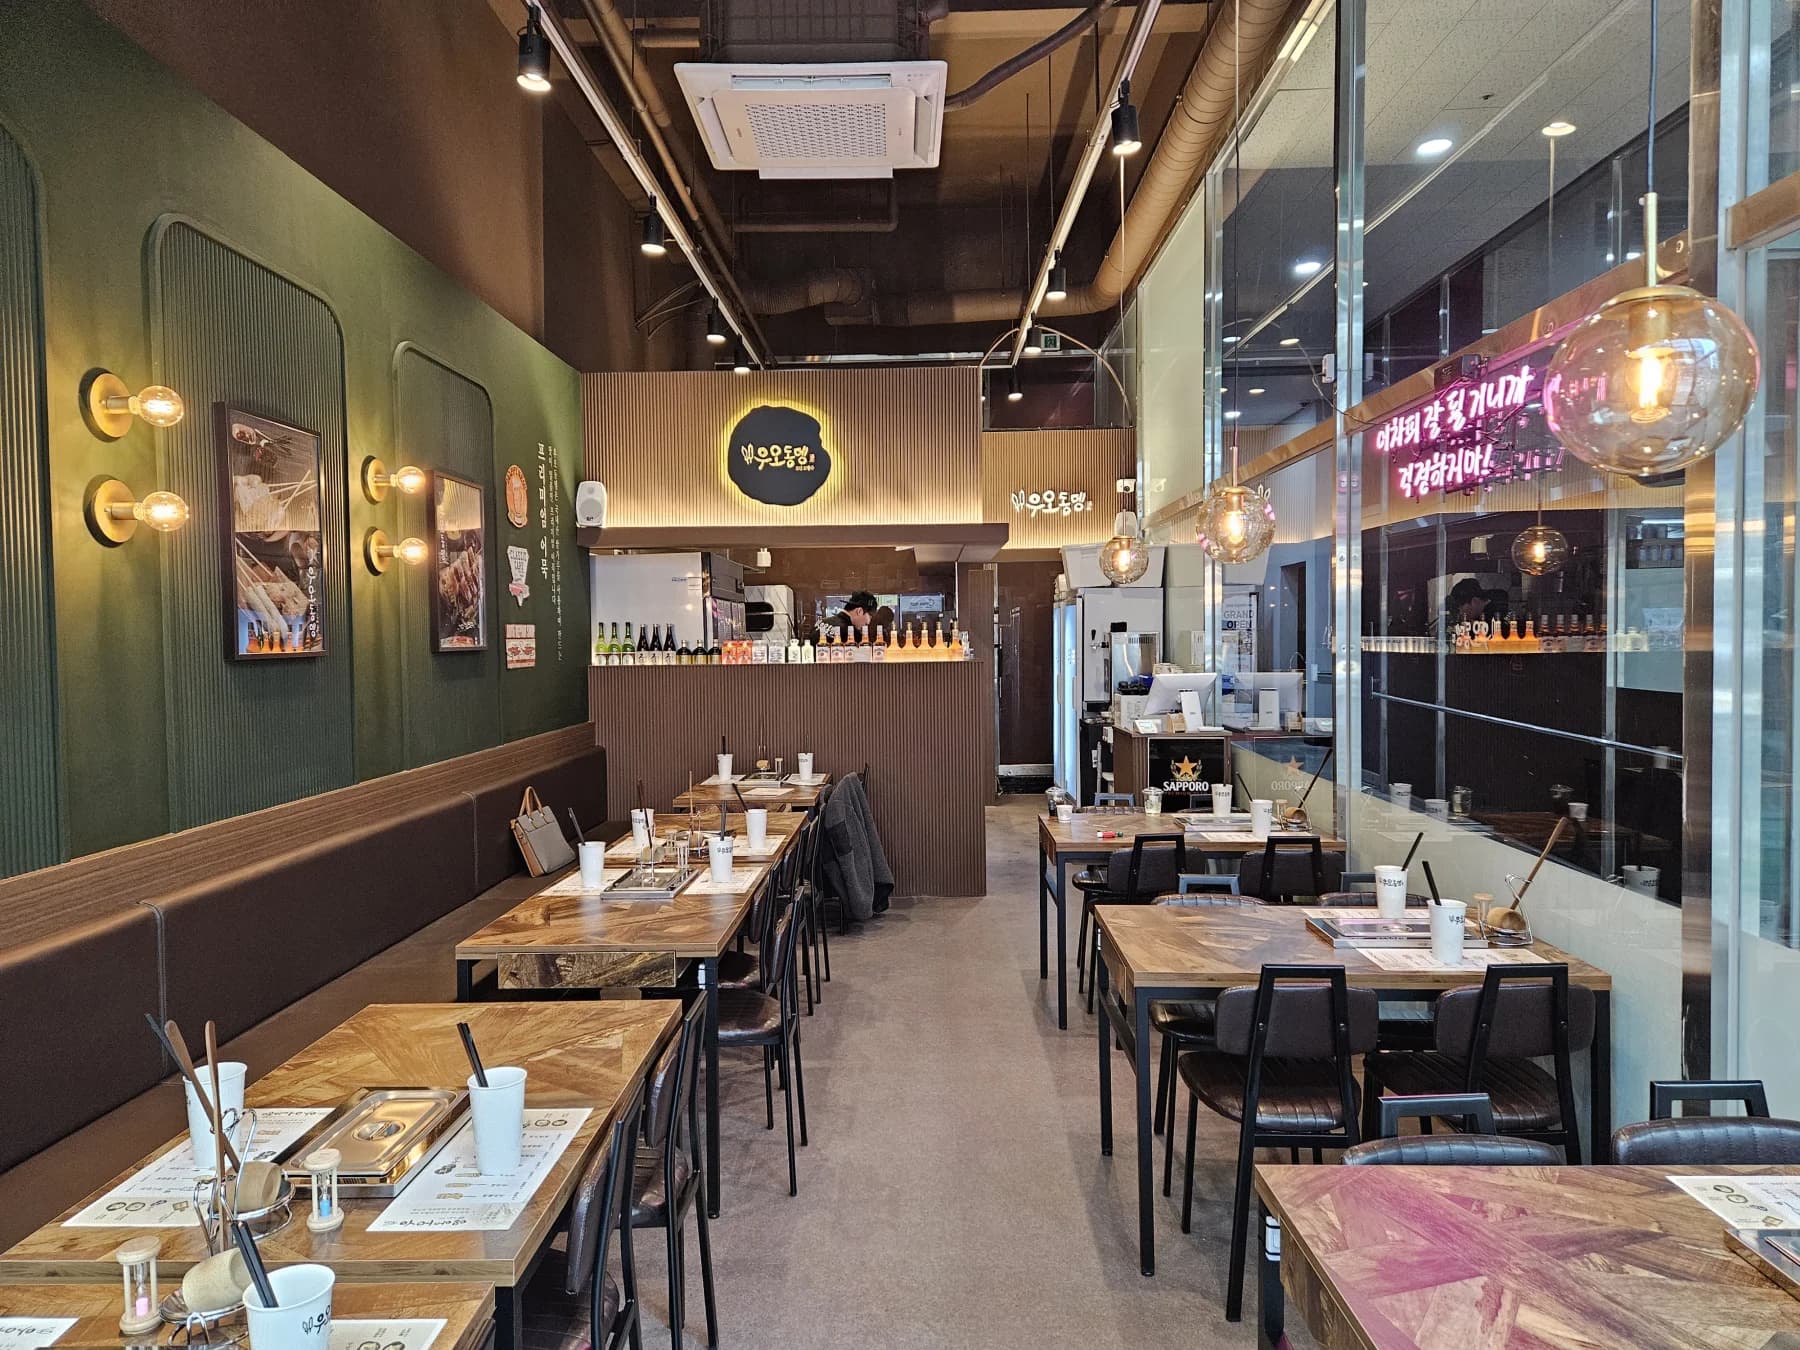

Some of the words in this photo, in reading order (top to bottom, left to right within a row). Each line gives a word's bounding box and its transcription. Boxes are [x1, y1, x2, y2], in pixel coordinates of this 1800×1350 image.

[1376, 412, 1421, 452] 어차피
[1423, 400, 1445, 440] 잘
[1446, 388, 1466, 432] 될
[1469, 365, 1535, 419] 거니까
[1163, 781, 1209, 792] SAPPORO
